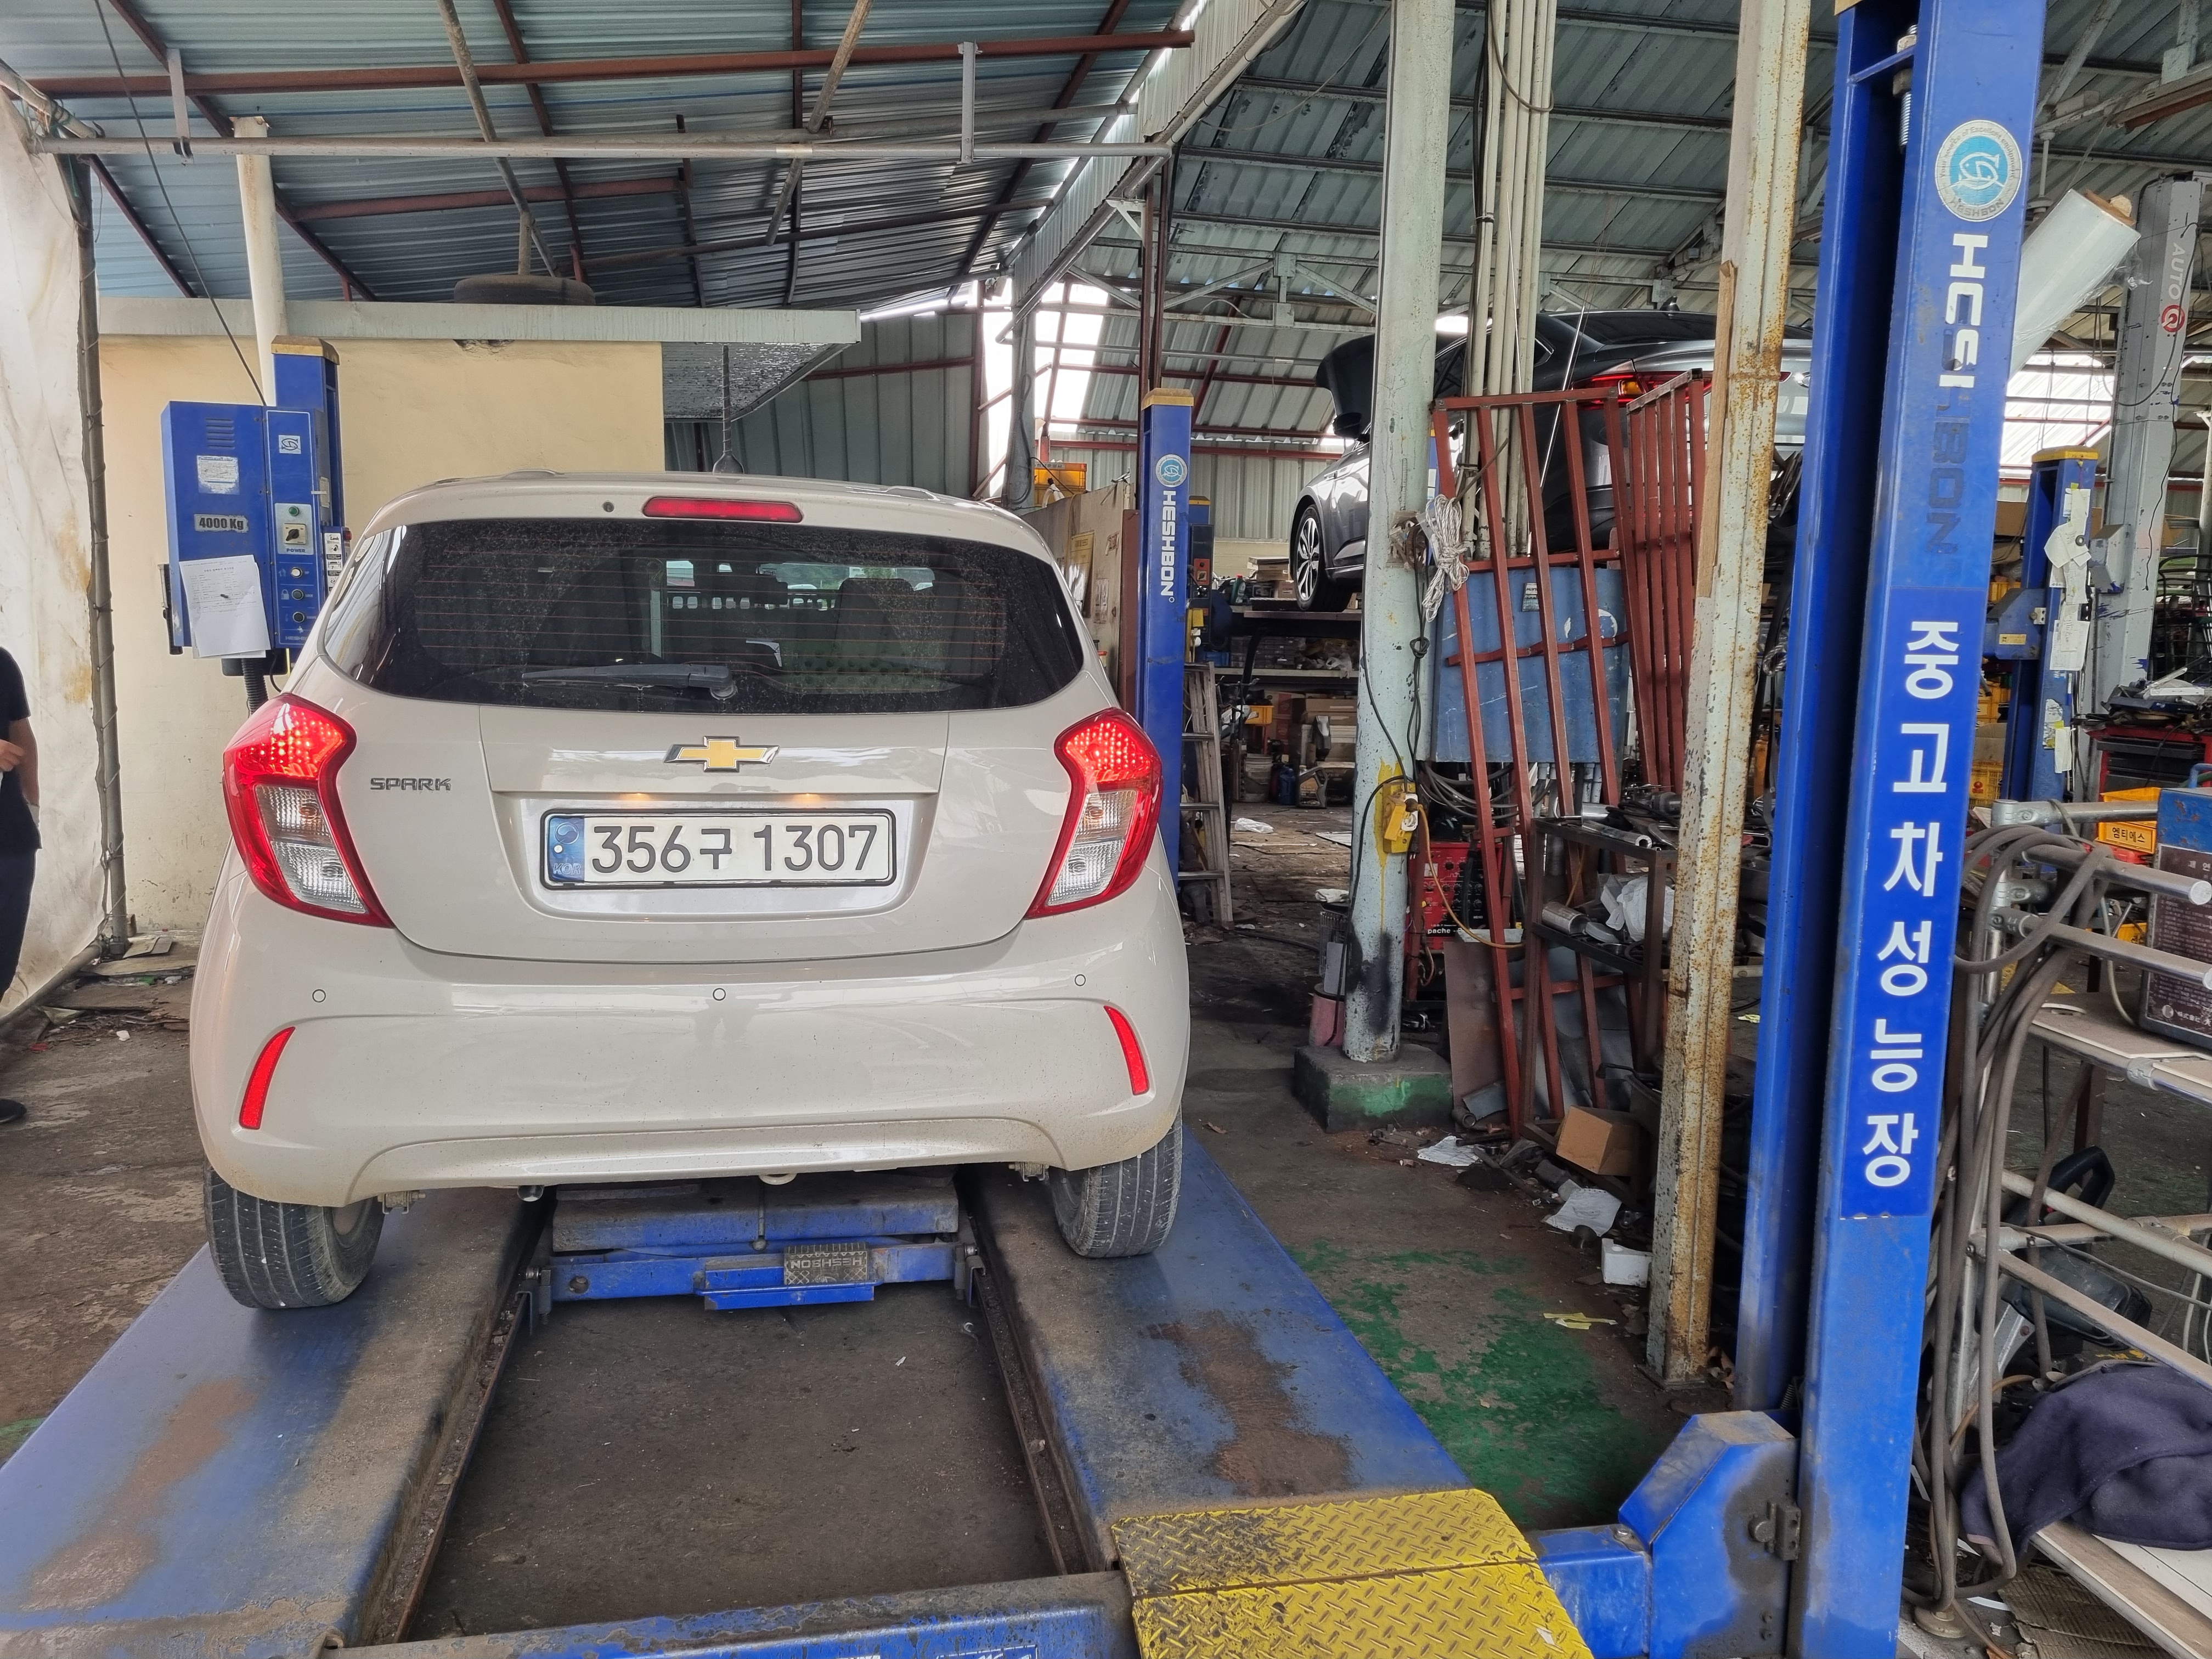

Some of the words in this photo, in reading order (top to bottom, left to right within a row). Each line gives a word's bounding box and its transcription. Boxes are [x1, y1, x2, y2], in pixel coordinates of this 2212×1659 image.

[2168, 242, 2186, 300] AUTO
[199, 517, 228, 529] 4000
[229, 518, 244, 531] Kg
[1160, 490, 1176, 596] HESHBON
[370, 778, 451, 791] SPARK
[2112, 827, 2146, 843] 엠티에스
[592, 825, 732, 873] 356구
[754, 825, 877, 871] 1307
[553, 863, 582, 874] KOR
[791, 1256, 862, 1269] HESHBON
